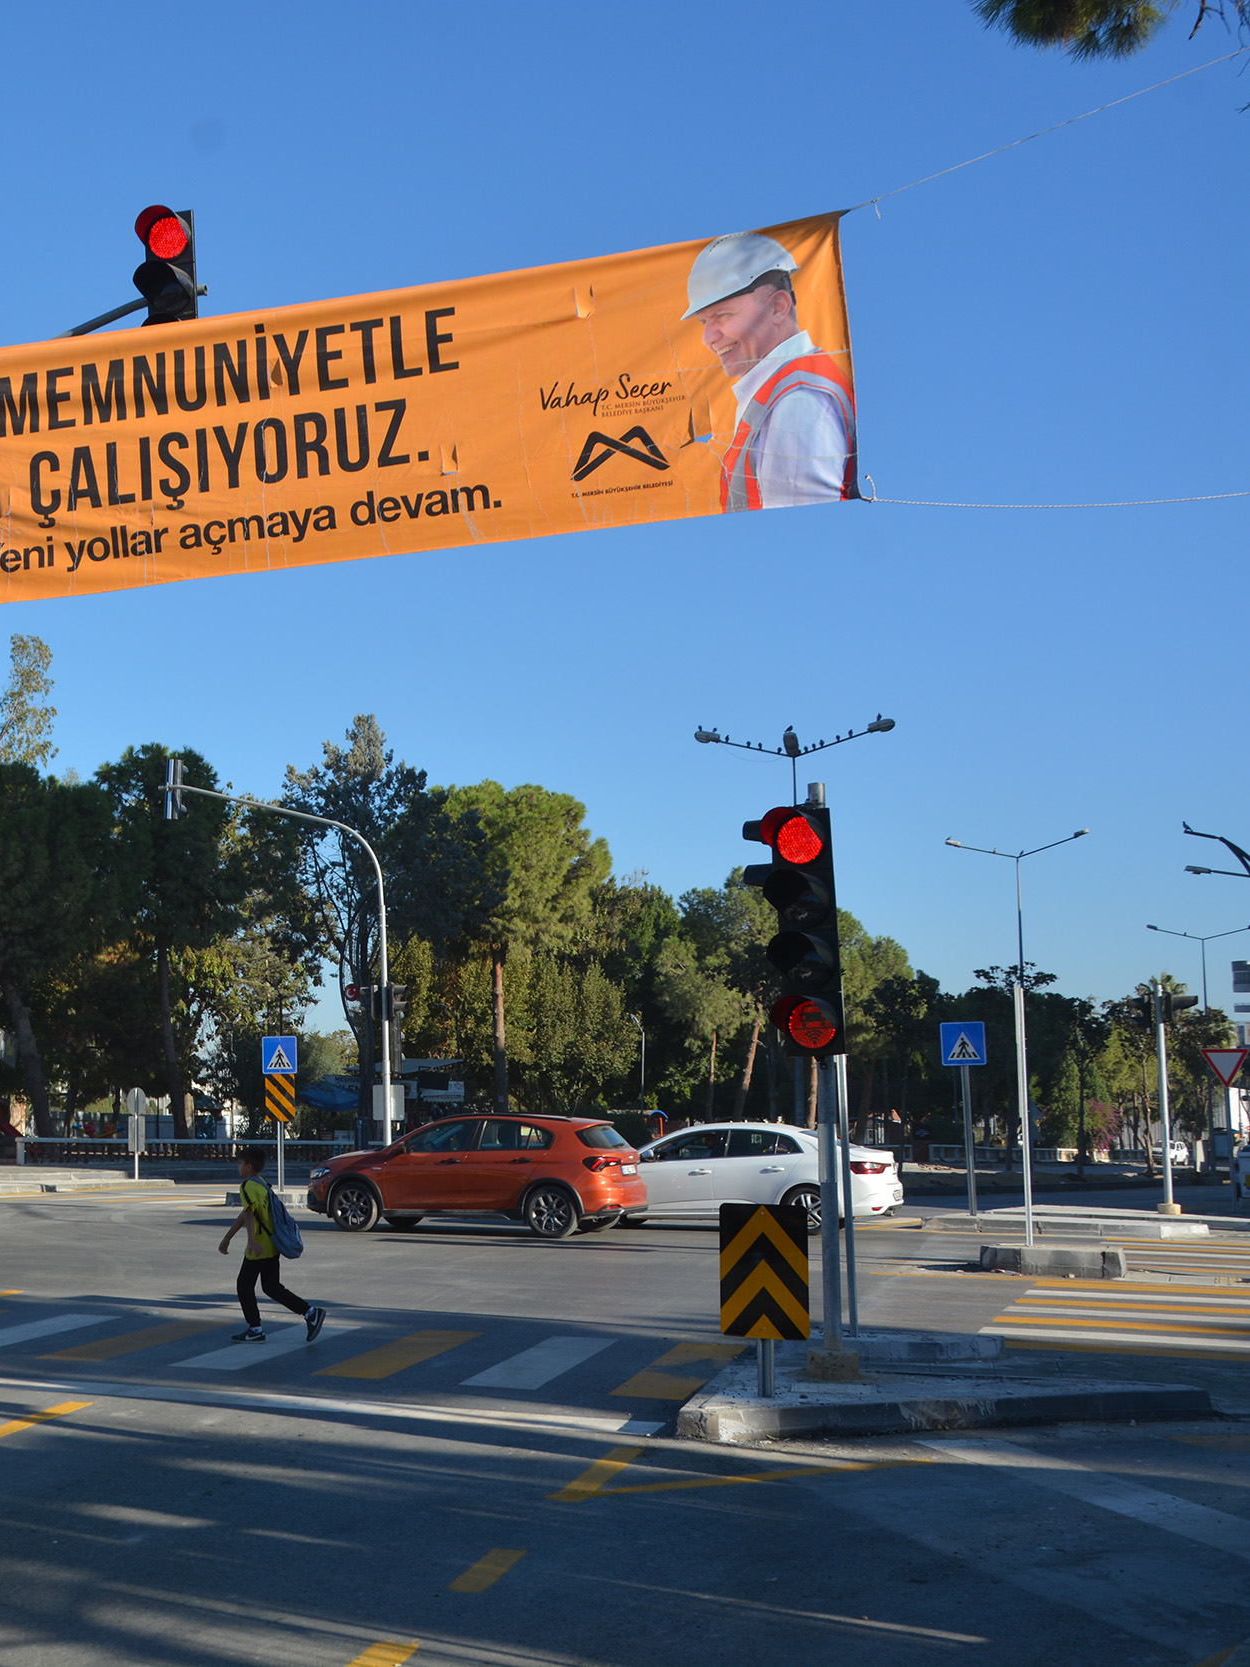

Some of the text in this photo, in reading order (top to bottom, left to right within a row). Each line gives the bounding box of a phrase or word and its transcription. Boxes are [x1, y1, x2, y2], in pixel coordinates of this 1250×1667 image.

[540, 373, 672, 416] Vahap Seçer
[614, 400, 641, 409] MERSİN
[642, 394, 687, 407] BÜYÜKŞEHİR
[601, 404, 664, 418] BELEDİYE BAŞKANI
[29, 398, 430, 529] ÇALIŞIYORUZ.
[582, 488, 604, 497] MERSİN
[605, 484, 641, 494] BÜYÜKŞEHİR
[642, 480, 674, 489] BELEDİYESİ
[64, 524, 169, 572] yollar
[179, 504, 337, 556] açmaya
[350, 483, 503, 527] devam.
